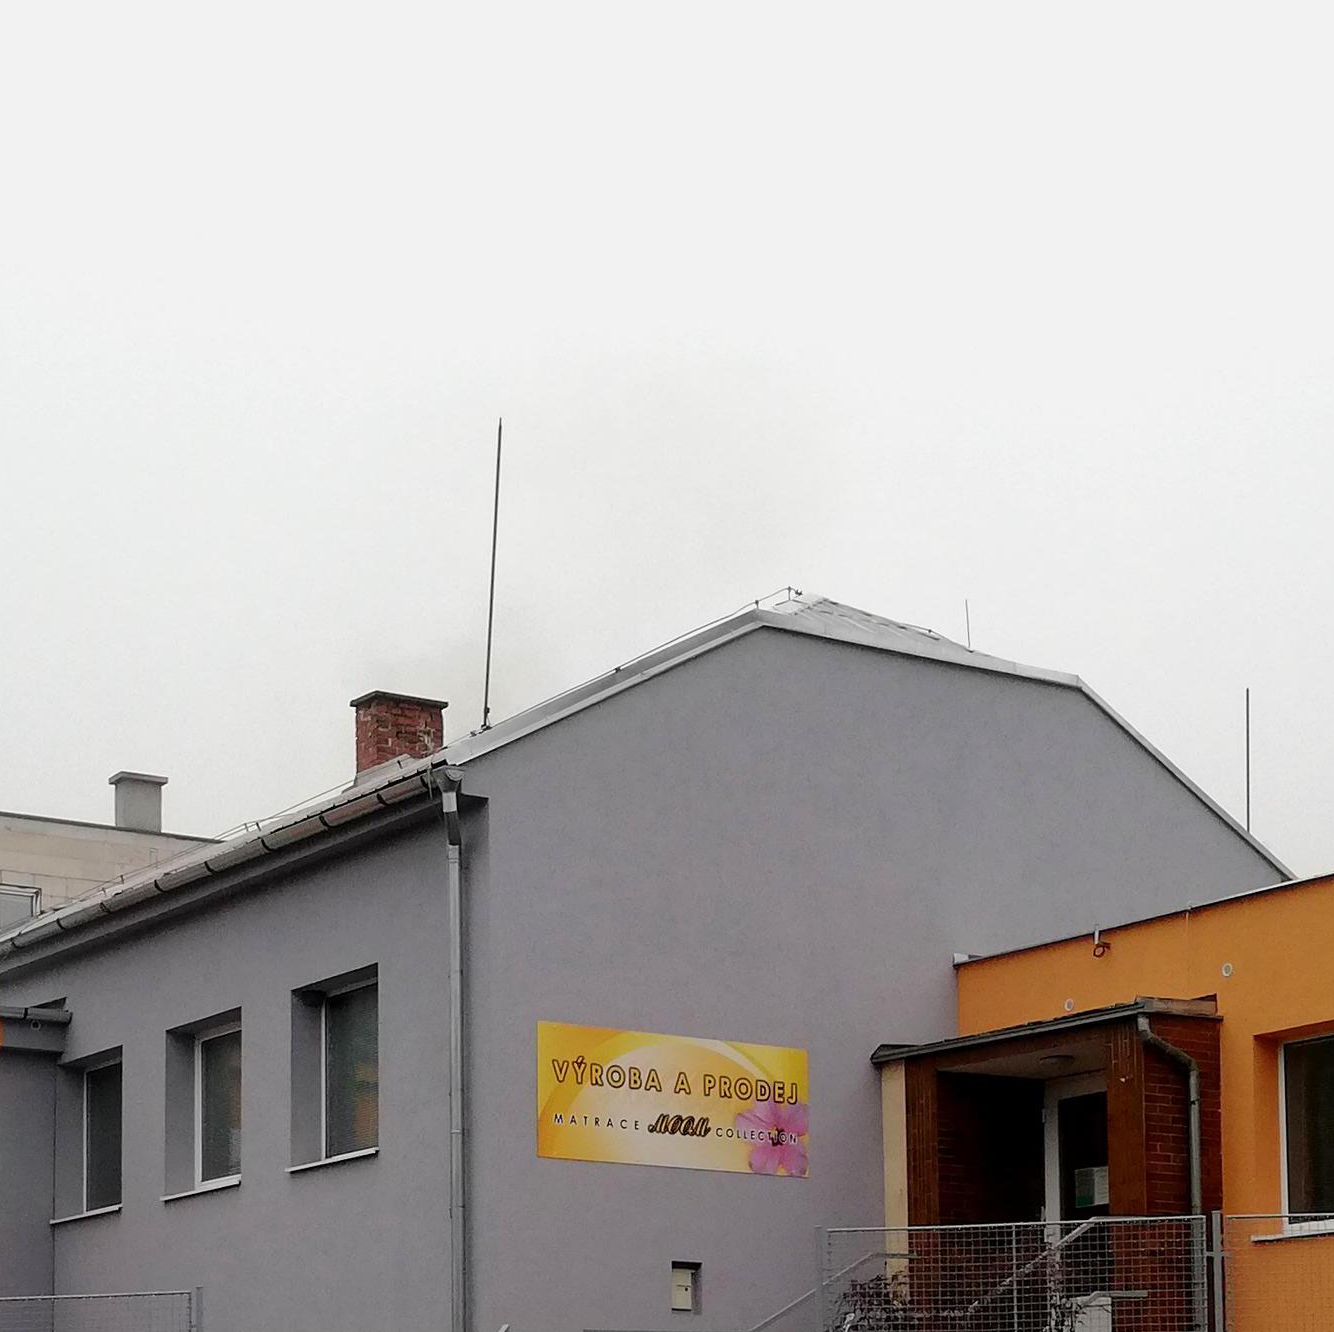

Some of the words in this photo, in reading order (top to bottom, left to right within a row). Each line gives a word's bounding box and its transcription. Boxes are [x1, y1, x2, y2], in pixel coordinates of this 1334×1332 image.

[551, 1056, 662, 1093] VÝROBA
[674, 1072, 691, 1095] A
[703, 1074, 799, 1105] PRODEJ
[554, 1113, 640, 1131] MATRACE
[716, 1127, 799, 1145] COLLECTION
